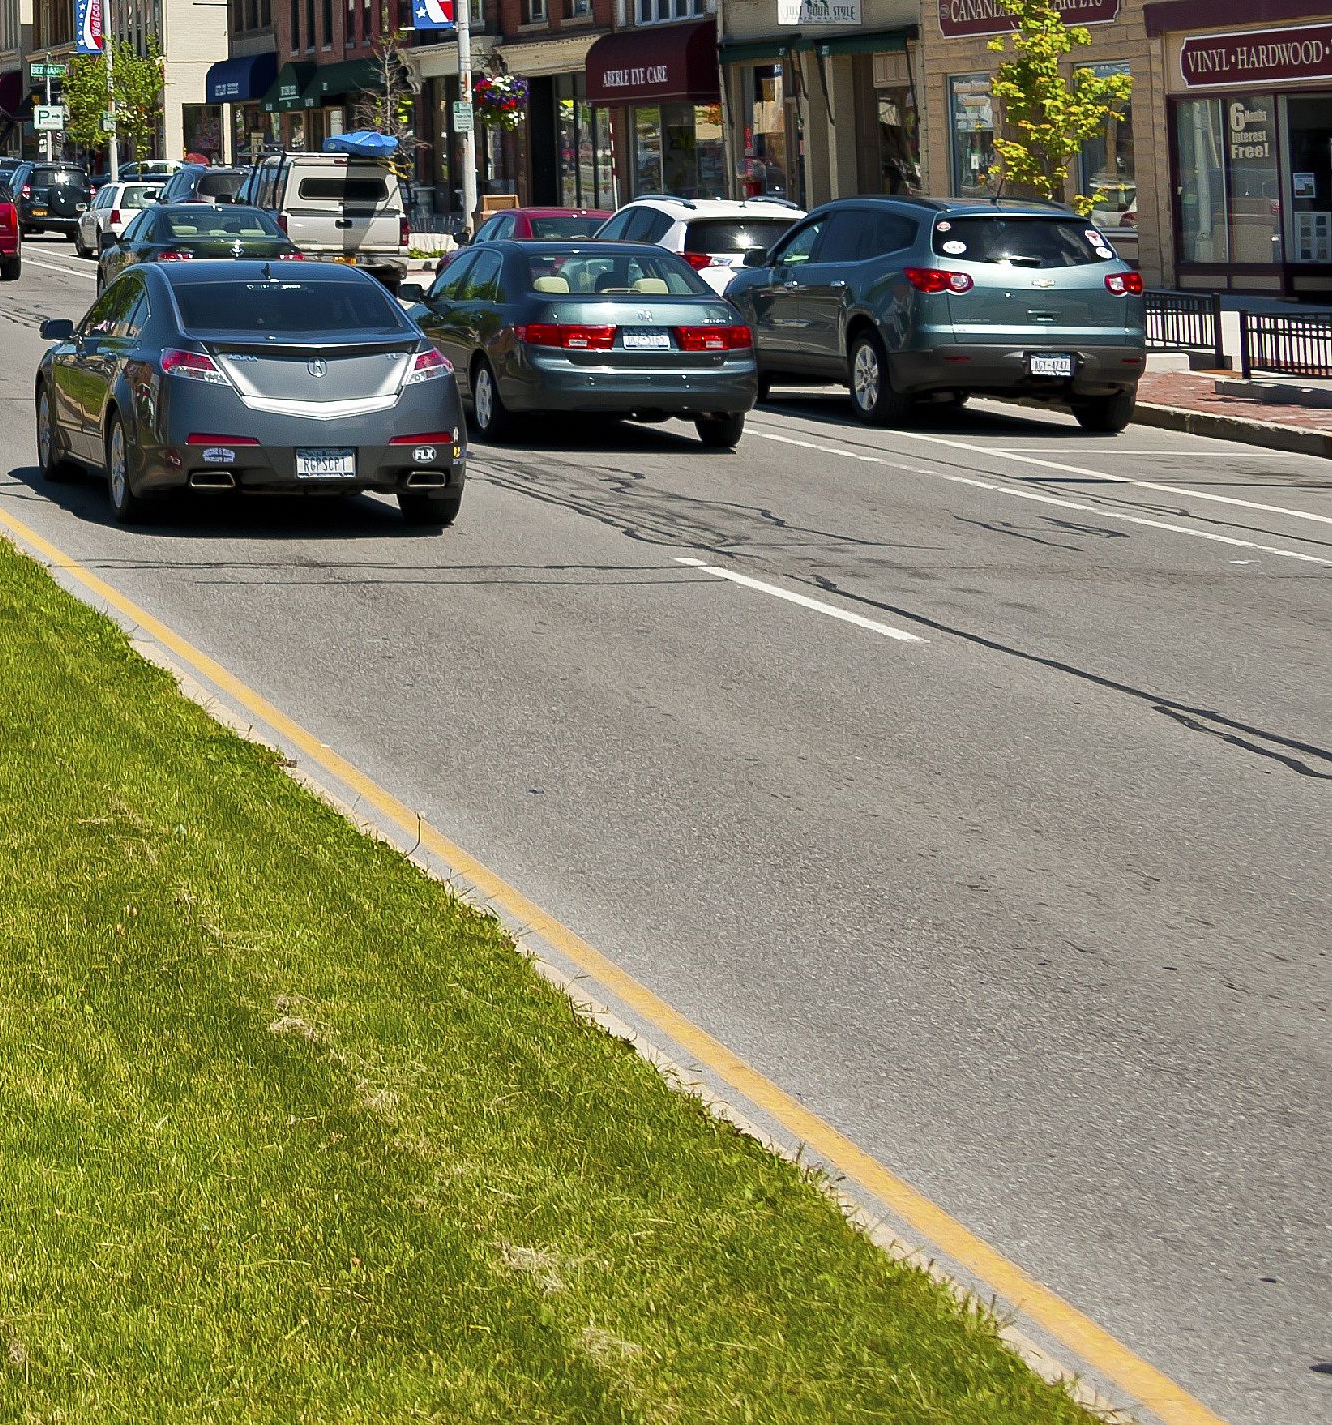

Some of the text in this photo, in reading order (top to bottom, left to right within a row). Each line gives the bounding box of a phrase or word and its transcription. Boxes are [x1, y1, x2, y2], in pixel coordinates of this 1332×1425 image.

[833, 5, 856, 20] STYLE
[1188, 40, 1323, 72] VINYL HARDWOOD
[631, 68, 645, 85] EYE
[647, 65, 668, 83] CARE
[39, 110, 49, 124] P
[1231, 102, 1246, 131] 6
[1232, 130, 1267, 143] Interest
[1232, 143, 1269, 159] Free!
[414, 448, 434, 461] FLX
